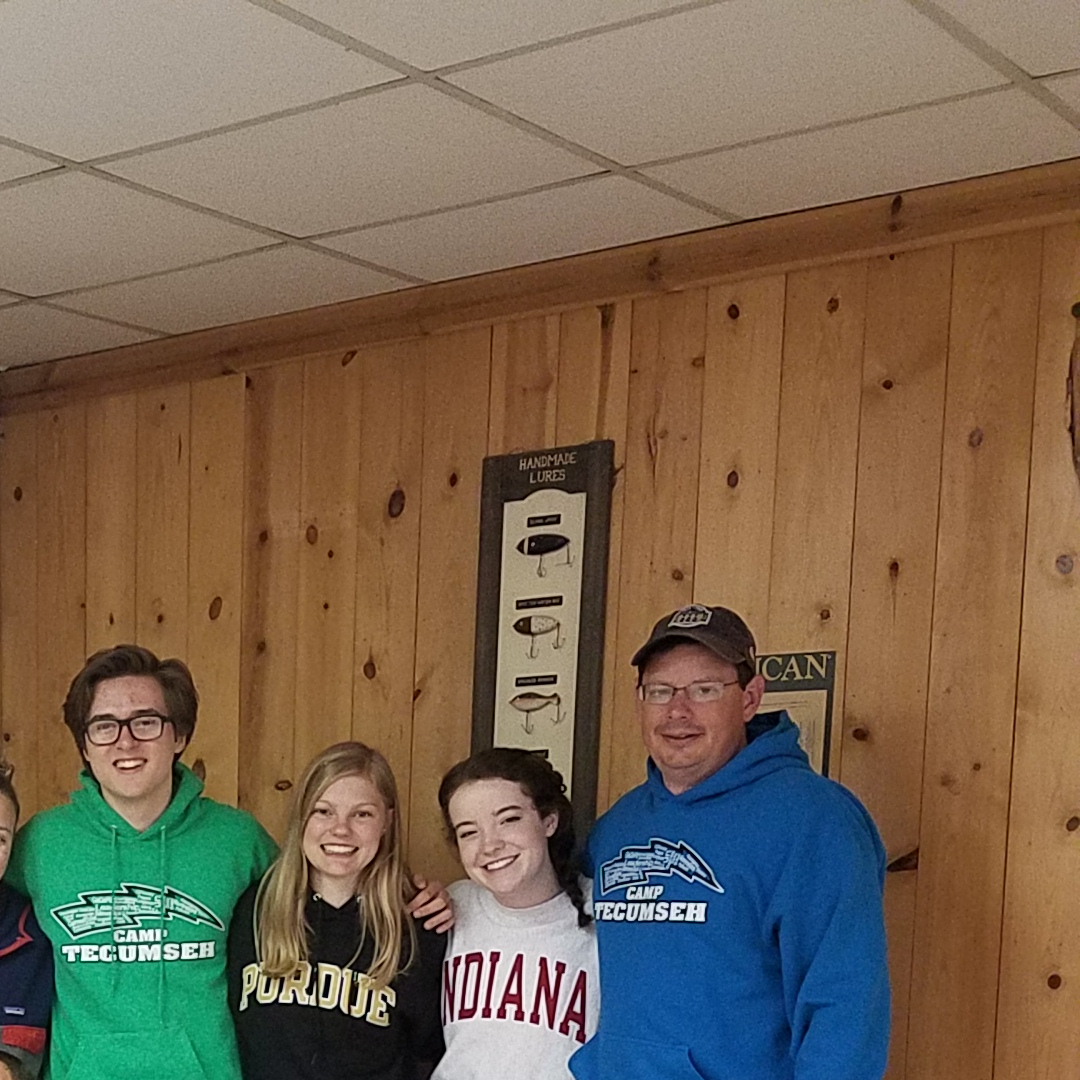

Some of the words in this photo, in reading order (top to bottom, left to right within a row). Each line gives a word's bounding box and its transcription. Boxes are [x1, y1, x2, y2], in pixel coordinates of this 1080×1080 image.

[519, 452, 577, 470] HANDMADE
[529, 469, 566, 483] LURES
[755, 654, 828, 682] ICAN
[626, 885, 664, 900] CAMP
[594, 901, 707, 922] TECUMSEH
[113, 928, 168, 943] CAMP
[61, 941, 216, 962] TECUMSEH
[239, 961, 396, 1027] PURDUE
[443, 950, 587, 1044] NDIANA
